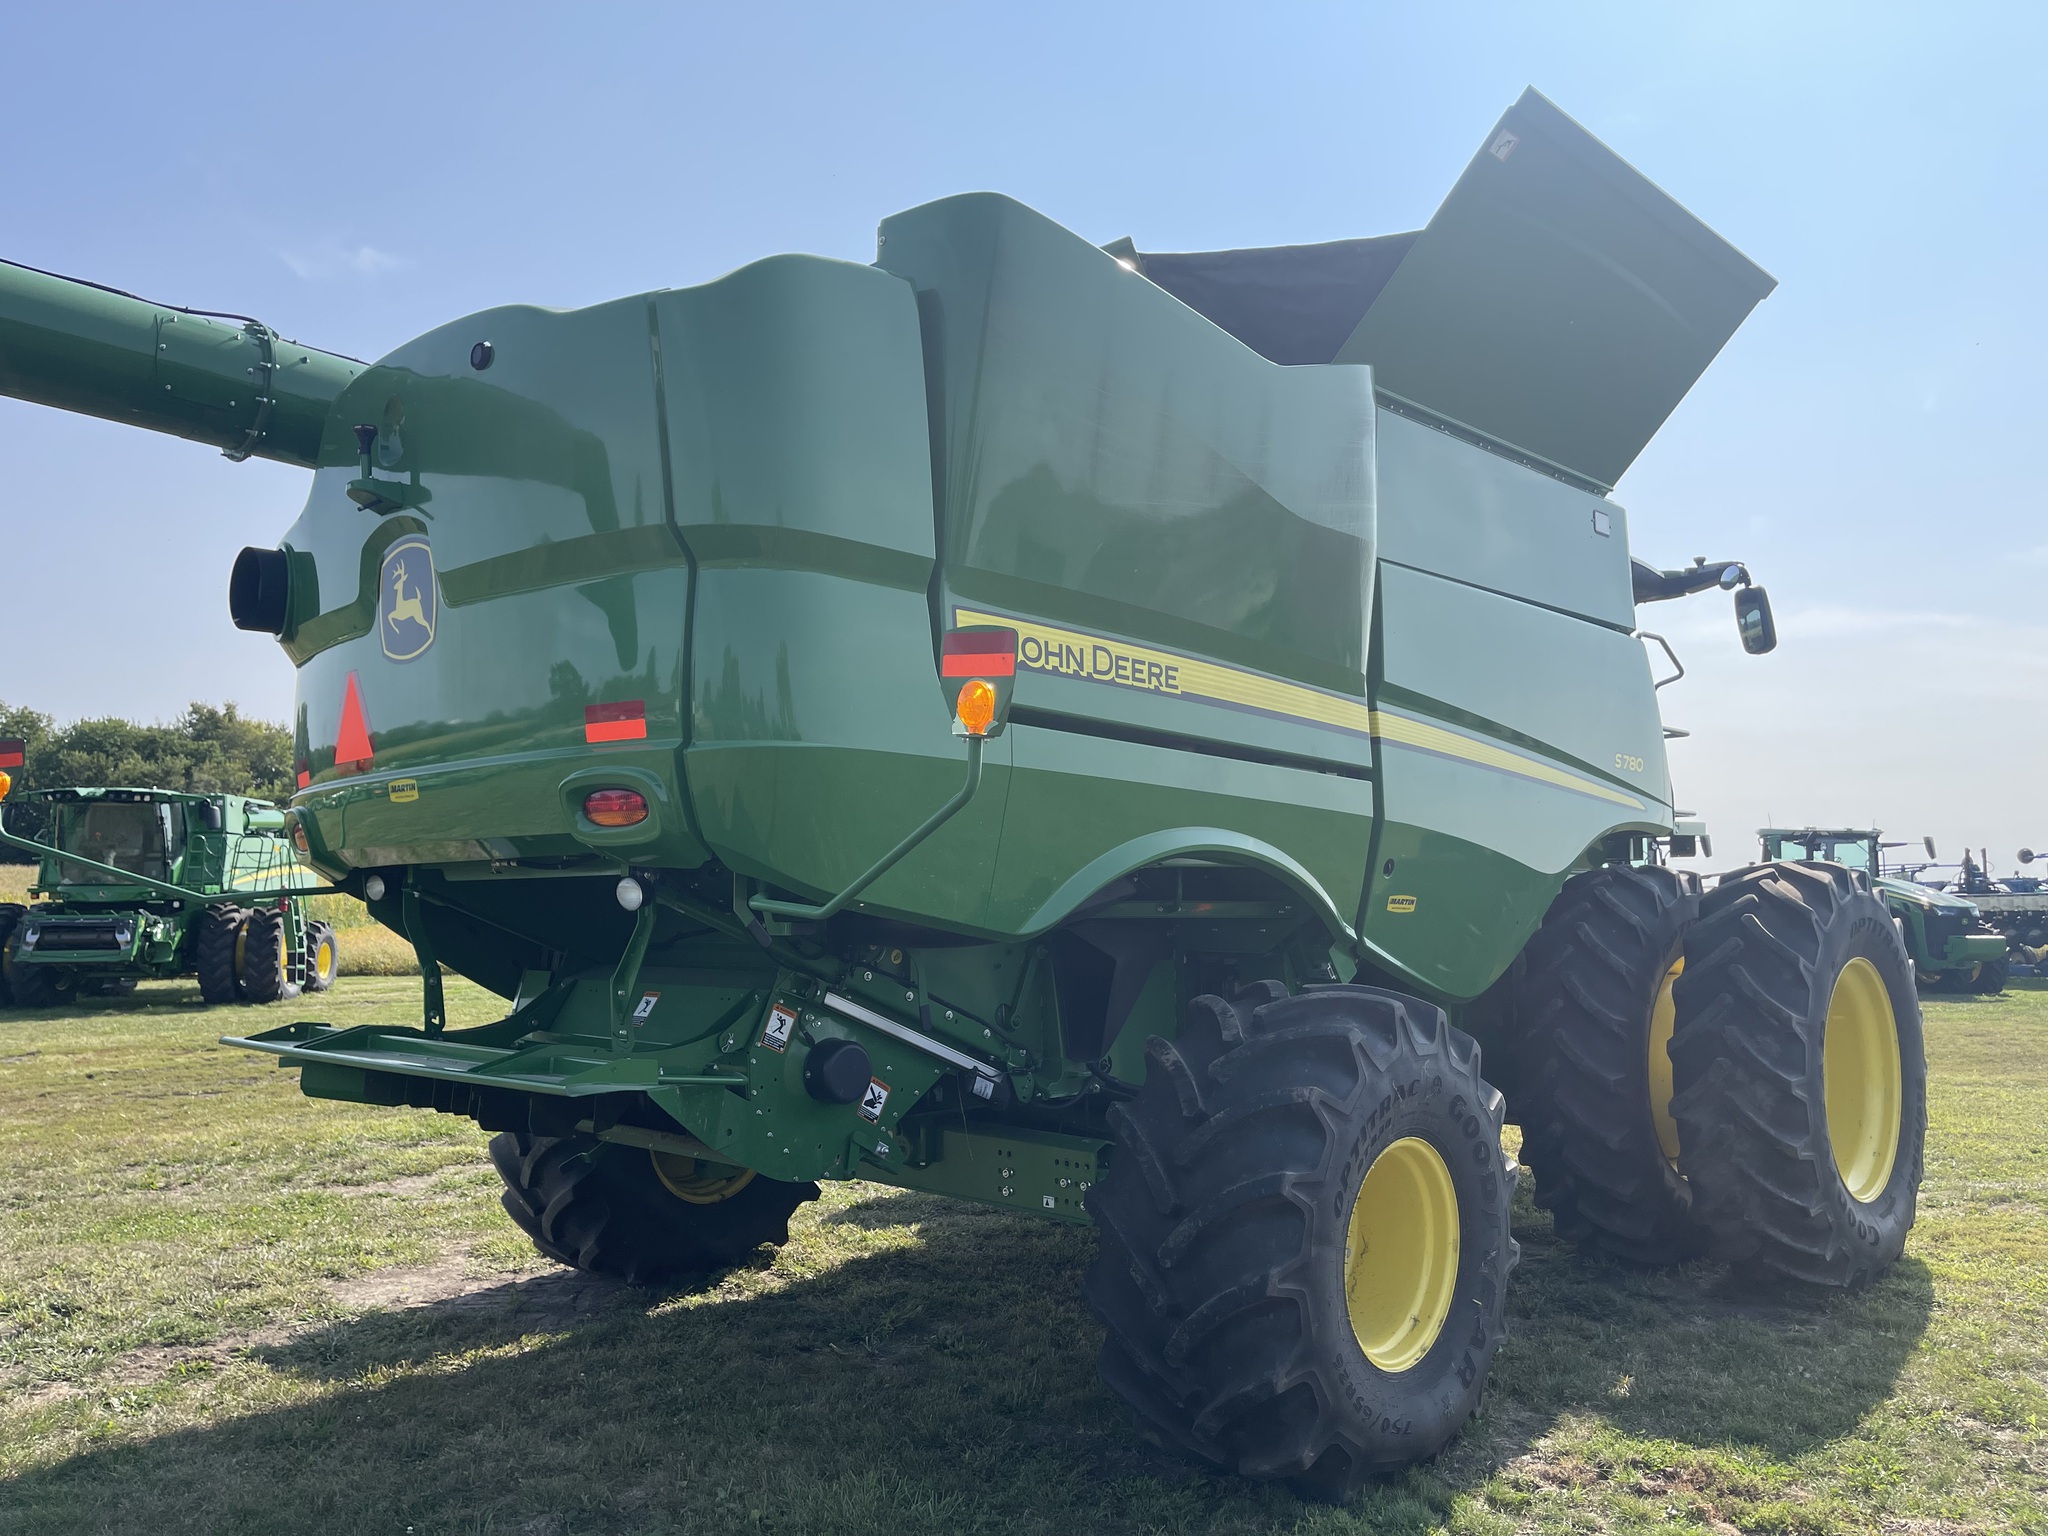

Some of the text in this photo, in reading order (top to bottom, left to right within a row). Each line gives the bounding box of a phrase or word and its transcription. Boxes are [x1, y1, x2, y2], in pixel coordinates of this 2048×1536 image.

[1021, 637, 1180, 690] OHN DEERE
[1614, 752, 1644, 773] S780
[390, 782, 416, 794] MARTIN
[1388, 897, 1416, 906] MARTIN
